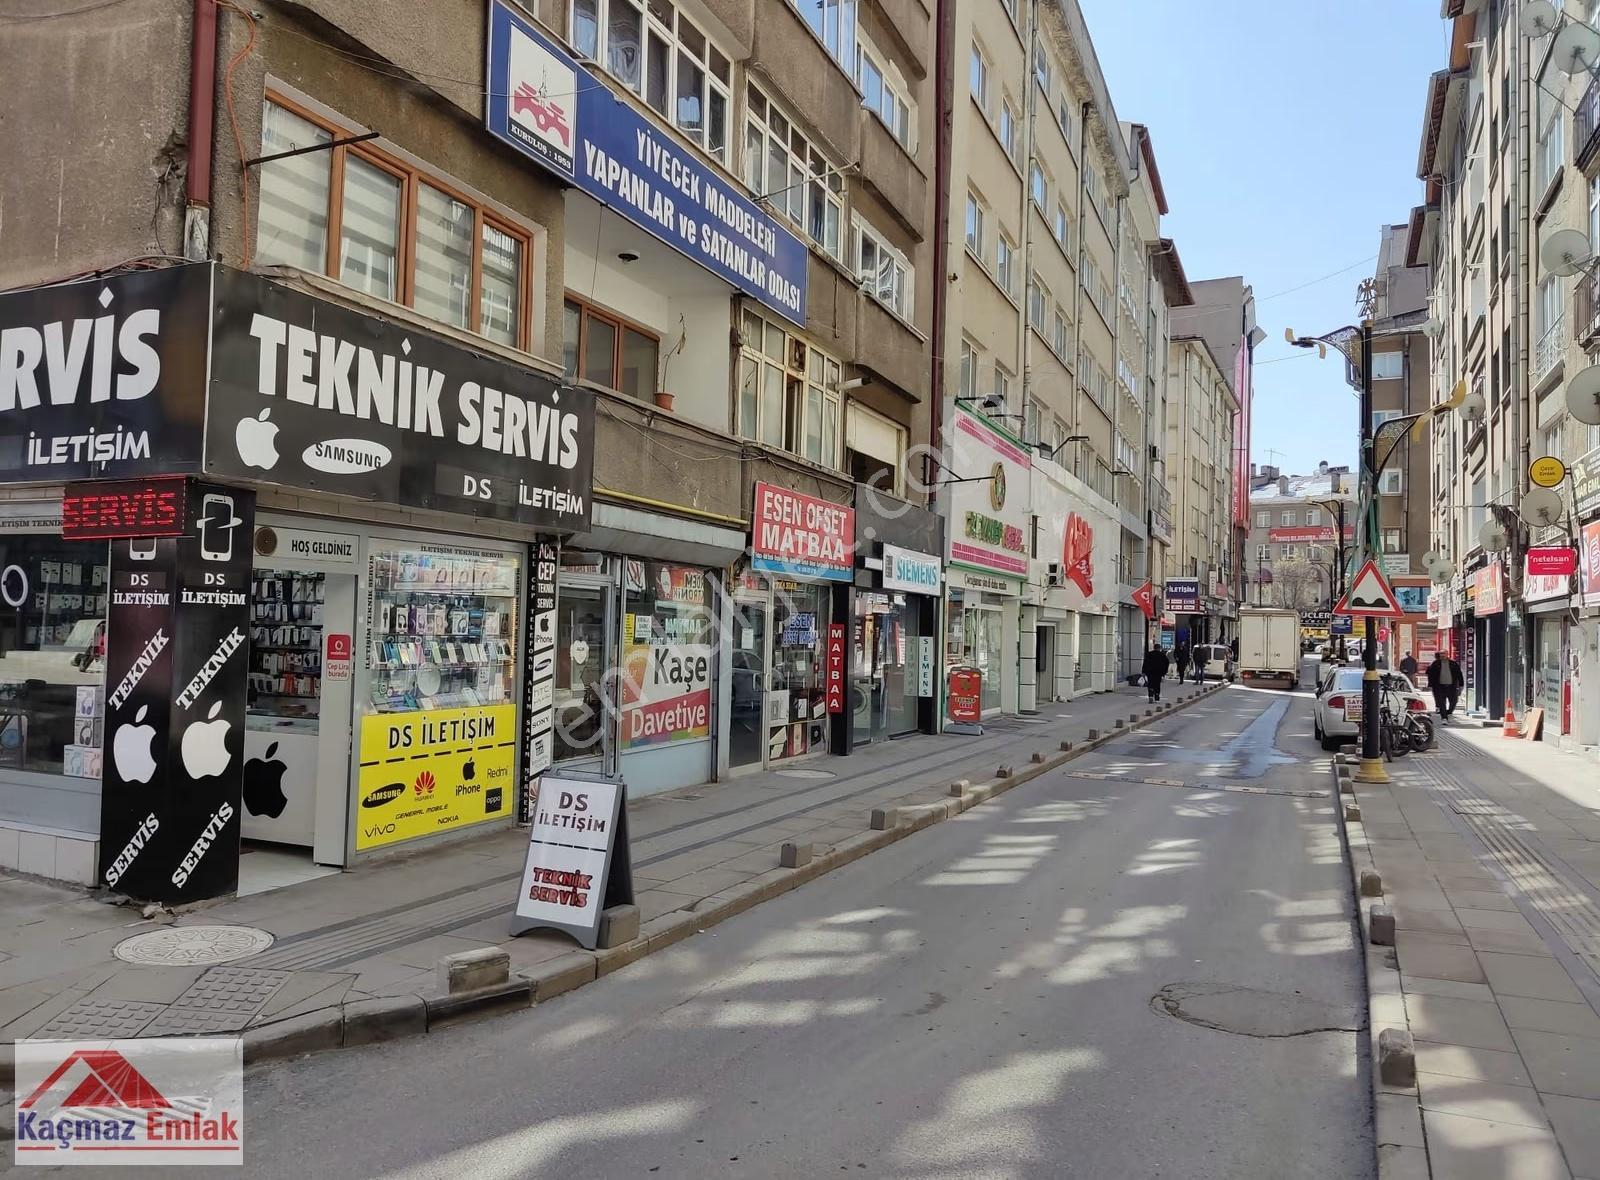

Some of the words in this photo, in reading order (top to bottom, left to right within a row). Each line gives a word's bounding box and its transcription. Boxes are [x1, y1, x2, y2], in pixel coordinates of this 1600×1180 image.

[511, 123, 547, 156] KURULUŞ
[553, 152, 571, 170] 1953
[637, 127, 700, 205] YİYECEK
[705, 183, 775, 258] MADDELERİ
[584, 139, 674, 232] YAPANLAR
[679, 213, 697, 245] ve
[701, 227, 765, 291] SATANLAR
[768, 265, 801, 313] ODASI
[250, 313, 445, 437] TEKNİK
[457, 381, 579, 469] SERVİS
[28, 425, 150, 471] İLETİŞİM
[315, 443, 382, 468] SAMSUNG
[62, 489, 176, 529] SERVİS
[463, 474, 492, 500] DS
[519, 479, 583, 517] İLETİŞİM
[763, 491, 801, 525] ESEN
[806, 502, 847, 536] OFSET
[291, 539, 310, 556] HOŞ
[312, 540, 352, 556] GELDİNİZ
[761, 522, 845, 562] MATBAA
[130, 574, 149, 586] DS
[205, 573, 226, 586] DS
[538, 561, 555, 581] CEP
[895, 557, 937, 586] SIEMENS
[113, 589, 169, 608] İLETİŞİM
[181, 588, 246, 608] İLETİŞİM
[109, 628, 169, 711] TEKNİK
[175, 626, 246, 711] TEKNİK
[654, 648, 707, 692] Kaşe
[830, 629, 842, 708] MATBAA
[389, 725, 412, 749] DS
[421, 710, 495, 745] İLETİŞİM
[531, 710, 548, 722] SONY
[631, 700, 706, 739] Davetiye
[486, 765, 508, 779] Redmi
[367, 786, 402, 802] SAMSUNG
[455, 784, 481, 796] iPhone
[558, 791, 589, 811] DS
[437, 815, 459, 825] NOKIA
[538, 809, 606, 832] İLETİŞİM
[105, 812, 160, 887] SERVİS
[171, 802, 234, 889] SERVİS
[533, 867, 593, 890] TEKNİK
[529, 886, 588, 908] SERVİS
